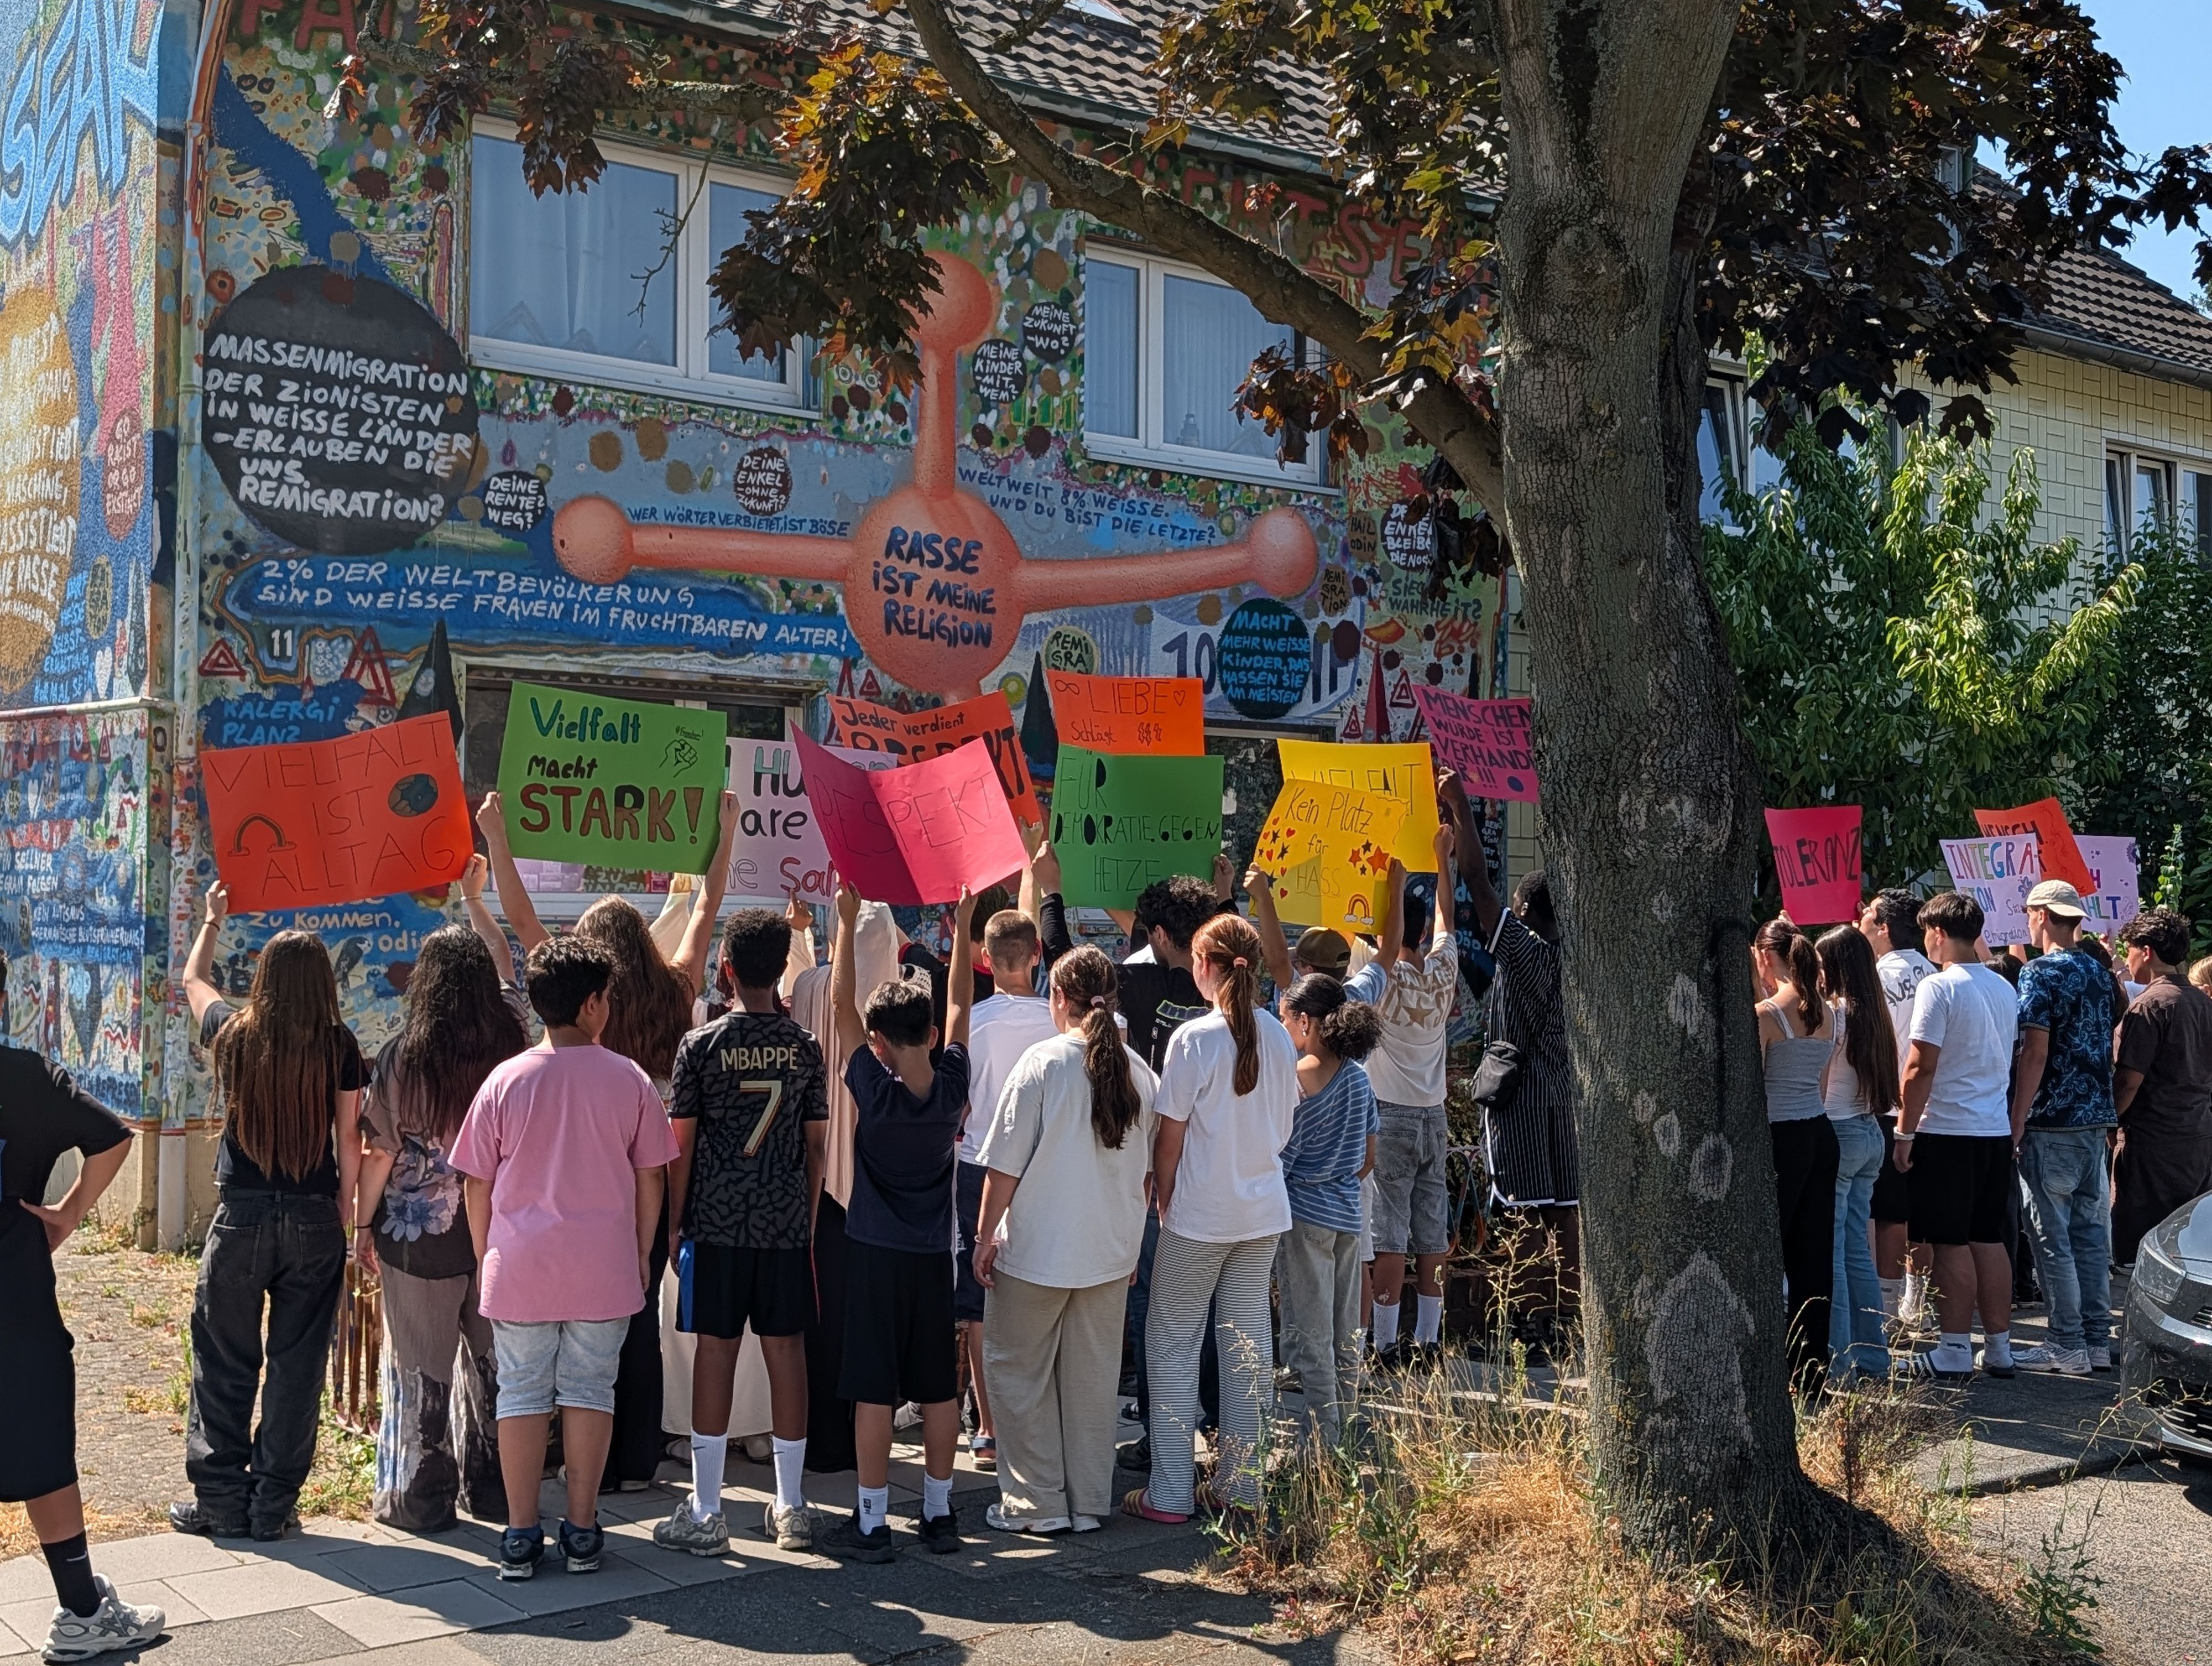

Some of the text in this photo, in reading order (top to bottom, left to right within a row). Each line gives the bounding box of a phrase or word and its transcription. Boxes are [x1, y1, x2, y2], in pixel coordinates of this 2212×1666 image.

[1023, 315, 1077, 335] ZUKUNFT
[205, 369, 264, 397] DER
[359, 418, 472, 459] LÄNDER
[240, 457, 305, 484] UNS
[737, 470, 783, 488] ENKEL
[990, 493, 1027, 511] UND
[1034, 501, 1056, 517] DU
[1061, 489, 1086, 508] 8%
[488, 507, 534, 529] WEG?
[629, 507, 658, 522] WER
[664, 506, 715, 525] WÖRTER
[808, 518, 850, 537] BÖSE
[885, 525, 983, 575] RASSE
[262, 559, 314, 581] 2%
[327, 561, 388, 584] DER
[1233, 611, 1294, 632] MACHT
[775, 623, 848, 652] ALTER!
[1221, 634, 1260, 650] MEHR
[1051, 650, 1086, 668] GRA
[1288, 657, 1311, 672] DAS
[1222, 671, 1276, 686] HASSEN
[1088, 680, 1170, 716] LIEBE
[1227, 687, 1247, 701] AM
[529, 696, 641, 745] Vielfalt
[836, 699, 965, 736] Jeder verdient
[1431, 716, 1485, 743] WÜRDE
[208, 719, 448, 793] VIELFALT
[1058, 749, 1107, 809] FÜR
[312, 786, 373, 836] IST
[520, 783, 704, 845] STARK!
[740, 809, 807, 840] are
[814, 770, 993, 858] RESPEKT
[1285, 787, 1373, 835] Kein Platz
[262, 816, 455, 897] ALLTAG
[1308, 834, 1328, 854] für
[1772, 826, 1860, 888] TOLERANZ
[1297, 865, 1340, 896] HASS
[739, 1080, 782, 1157] 7
